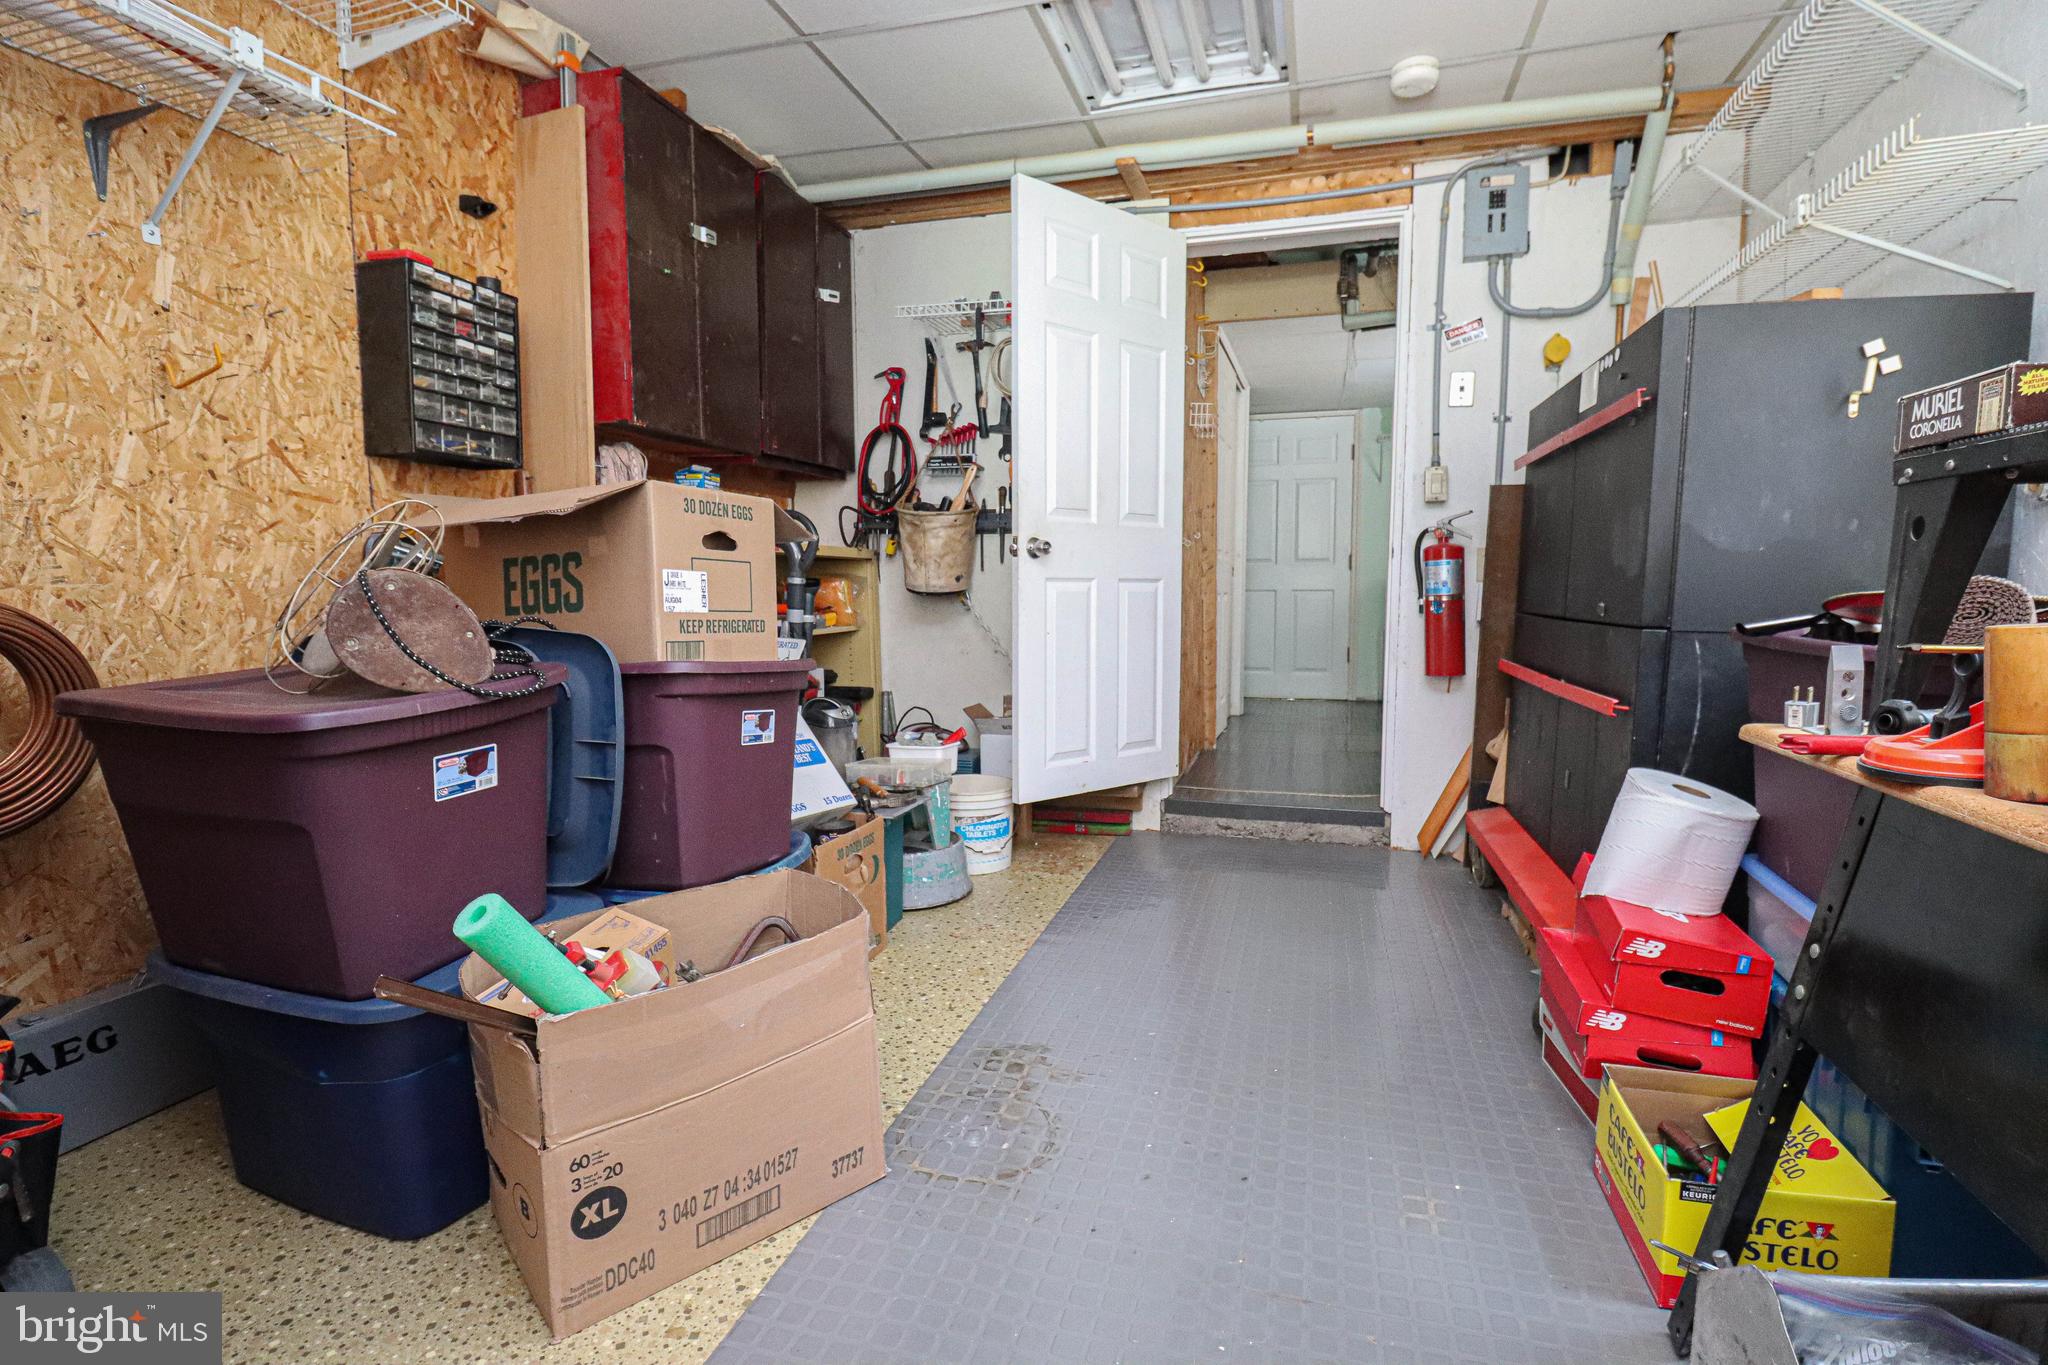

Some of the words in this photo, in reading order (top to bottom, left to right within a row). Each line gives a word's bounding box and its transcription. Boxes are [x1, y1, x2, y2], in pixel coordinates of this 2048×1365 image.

[1911, 387, 1964, 423] MURIEL
[684, 498, 696, 514] 30
[699, 500, 729, 519] DOZEN
[732, 504, 753, 521] EGGS
[503, 552, 584, 616] EGGS
[679, 619, 704, 634] KEEP
[706, 619, 766, 634] REFRIGERATED
[823, 797, 833, 806] 15
[966, 829, 996, 838] TABLETS
[14, 1025, 118, 1085] AEG
[1797, 1124, 1819, 1143] YO
[569, 1154, 591, 1173] 60
[571, 1178, 582, 1193] 3
[603, 1162, 624, 1181] 20
[658, 1209, 667, 1231] 3
[673, 1195, 697, 1224] 040
[703, 1184, 719, 1212] Z7
[831, 1146, 864, 1178] 37737
[579, 1198, 619, 1230] XL
[605, 1248, 655, 1292] DDC40
[1743, 1241, 1839, 1271] STELO
